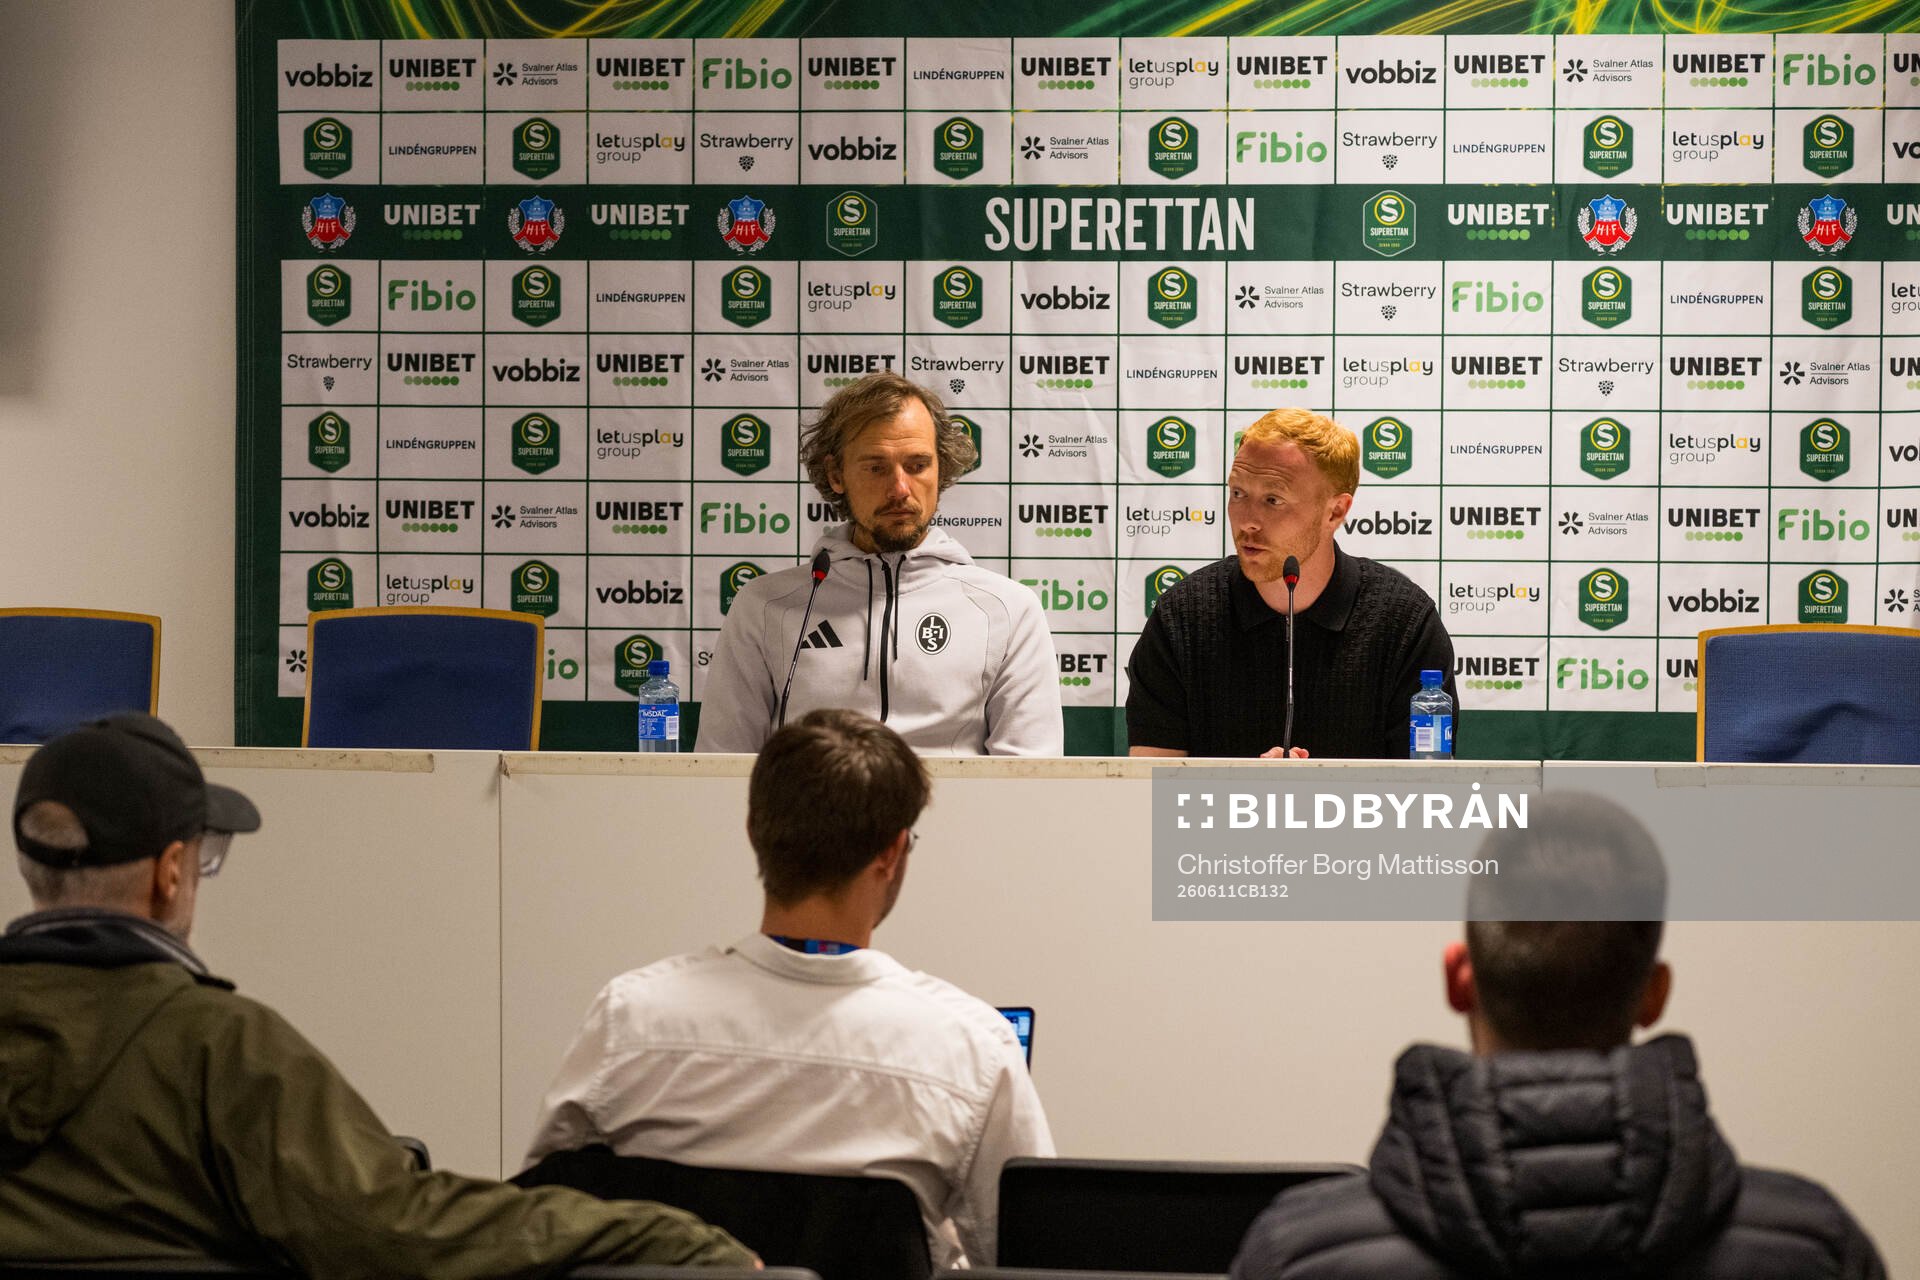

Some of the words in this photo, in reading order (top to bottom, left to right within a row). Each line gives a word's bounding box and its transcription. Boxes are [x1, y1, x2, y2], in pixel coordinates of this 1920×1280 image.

[389, 59, 476, 78] UNIBET
[522, 62, 553, 72] Svalner
[556, 62, 577, 72] Atlas
[597, 58, 685, 77] UNIBET
[808, 57, 896, 76] UNIBET
[1021, 57, 1111, 76] UNIBET
[1129, 58, 1218, 76] letusplay
[1237, 56, 1327, 75] UNIBET
[1455, 55, 1545, 74] UNIBET
[1593, 59, 1628, 68] Svalner
[1631, 59, 1653, 68] Atlas
[1673, 54, 1765, 73] UNIBET
[1783, 54, 1876, 85] Fibio
[285, 63, 373, 87] vobbiz
[703, 58, 792, 89] Fibio
[914, 68, 1004, 80] LINDÉNGRUPPEN
[1346, 60, 1436, 84] vobbiz
[1593, 74, 1632, 82] Advisors
[522, 76, 558, 86] Advisors
[1129, 77, 1174, 89] group
[597, 133, 685, 152] letusplay
[700, 133, 793, 150] Strawberry
[1050, 137, 1084, 146] Svalner
[1087, 137, 1109, 146] Atlas
[1343, 132, 1437, 148] Strawberry
[1673, 131, 1764, 149] letusplay
[389, 144, 476, 155] LINDÉNGRUPPEN
[808, 136, 896, 160] vobbiz
[1236, 132, 1327, 163] Fibio
[1454, 142, 1545, 153] LINDÉNGRUPPEN
[310, 151, 347, 161] SUPERETTAN
[519, 152, 555, 161] SUPERETTAN
[597, 152, 641, 164] group
[940, 152, 977, 161] SUPERETTAN
[1050, 150, 1088, 160] Advisors
[1154, 152, 1192, 161] SUPERETTAN
[1589, 150, 1627, 160] SUPERETTAN
[1673, 151, 1718, 162] group
[1809, 150, 1848, 159] SUPERETTAN
[385, 205, 480, 225] UNIBET
[592, 205, 689, 225] UNIBET
[1448, 204, 1549, 225] UNIBET
[1666, 204, 1768, 225] UNIBET
[985, 197, 1255, 251] SUPERETTAN
[833, 227, 871, 236] SUPERETTAN
[1369, 227, 1409, 236] SUPERETTAN
[389, 280, 476, 311] Fibio
[596, 290, 685, 302] LINDÉNGRUPPEN
[808, 281, 895, 300] letusplay
[1264, 286, 1298, 295] Svalner
[1301, 286, 1324, 295] Atlas
[1342, 283, 1436, 299] Strawberry
[1452, 282, 1543, 312] Fibio
[311, 299, 345, 308] SUPERETTAN
[518, 299, 555, 308] SUPERETTAN
[1021, 286, 1110, 309] vobbiz
[1671, 292, 1763, 304] LINDÉNGRUPPEN
[728, 300, 765, 309] SUPERETTAN
[808, 300, 852, 312] group
[939, 300, 977, 310] SUPERETTAN
[1154, 301, 1192, 310] SUPERETTAN
[1264, 300, 1303, 309] Advisors
[1587, 301, 1626, 310] SUPERETTAN
[1808, 301, 1846, 311] SUPERETTAN
[287, 353, 372, 371] Strawberry
[388, 353, 476, 372] UNIBET
[597, 354, 684, 372] UNIBET
[730, 359, 764, 368] Svalner
[767, 359, 789, 368] Atlas
[808, 355, 895, 373] UNIBET
[912, 356, 1004, 373] Strawberry
[1020, 356, 1109, 374] UNIBET
[1235, 357, 1324, 375] UNIBET
[1344, 358, 1433, 375] letusplay
[1452, 357, 1542, 375] UNIBET
[1559, 358, 1653, 374] Strawberry
[1670, 357, 1762, 376] UNIBET
[1810, 362, 1844, 371] Svalner
[1848, 362, 1870, 371] Atlas
[492, 358, 580, 382] vobbiz
[1127, 367, 1217, 378] LINDÉNGRUPPEN
[730, 373, 768, 382] Advisors
[1343, 374, 1388, 387] group
[1810, 376, 1848, 385] Advisors
[386, 437, 475, 449] LINDÉNGRUPPEN
[597, 429, 683, 447] letusplay
[1048, 435, 1082, 444] Svalner
[1085, 435, 1108, 444] Atlas
[1670, 433, 1760, 452] letusplay
[314, 445, 346, 455] SUPERETTAN
[518, 447, 554, 456] SUPERETTAN
[597, 448, 640, 459] group
[727, 448, 765, 457] SUPERETTAN
[1048, 449, 1087, 458] Advisors
[1153, 450, 1190, 460] SUPERETTAN
[1451, 443, 1542, 454] LINDÉNGRUPPEN
[1368, 451, 1407, 460] SUPERETTAN
[1586, 452, 1624, 461] SUPERETTAN
[1670, 451, 1716, 464] group
[1806, 453, 1844, 462] SUPERETTAN
[289, 503, 369, 528] vobbiz
[386, 500, 475, 519] UNIBET
[520, 506, 554, 515] Svalner
[556, 506, 578, 515] Atlas
[596, 502, 683, 520] UNIBET
[1019, 505, 1108, 523] UNIBET
[1127, 506, 1215, 525] letusplay
[1450, 507, 1541, 525] UNIBET
[701, 503, 790, 533] Fibio
[929, 514, 1003, 527] DÉNGRUPPEN
[1345, 511, 1432, 535] vobbiz
[1588, 512, 1623, 521] Svalner
[1626, 512, 1648, 521] Atlas
[1669, 509, 1760, 527] UNIBET
[520, 520, 557, 528] Advisors
[1127, 525, 1170, 536] group
[1588, 526, 1627, 535] Advisors
[1778, 509, 1869, 541] Fibio
[387, 574, 474, 593] letusplay
[314, 592, 350, 601] SUPERETTAN
[387, 592, 430, 605] group
[596, 580, 683, 604] vobbiz
[1450, 583, 1539, 602] letusplay
[516, 594, 554, 604] SUPERETTAN
[1668, 588, 1760, 613] vobbiz
[1450, 603, 1494, 613] group
[1584, 603, 1623, 612] SUPERETTAN
[1804, 605, 1843, 614] SUPERETTAN
[620, 669, 649, 678] SUPERETT
[1557, 658, 1649, 690] Fibio
